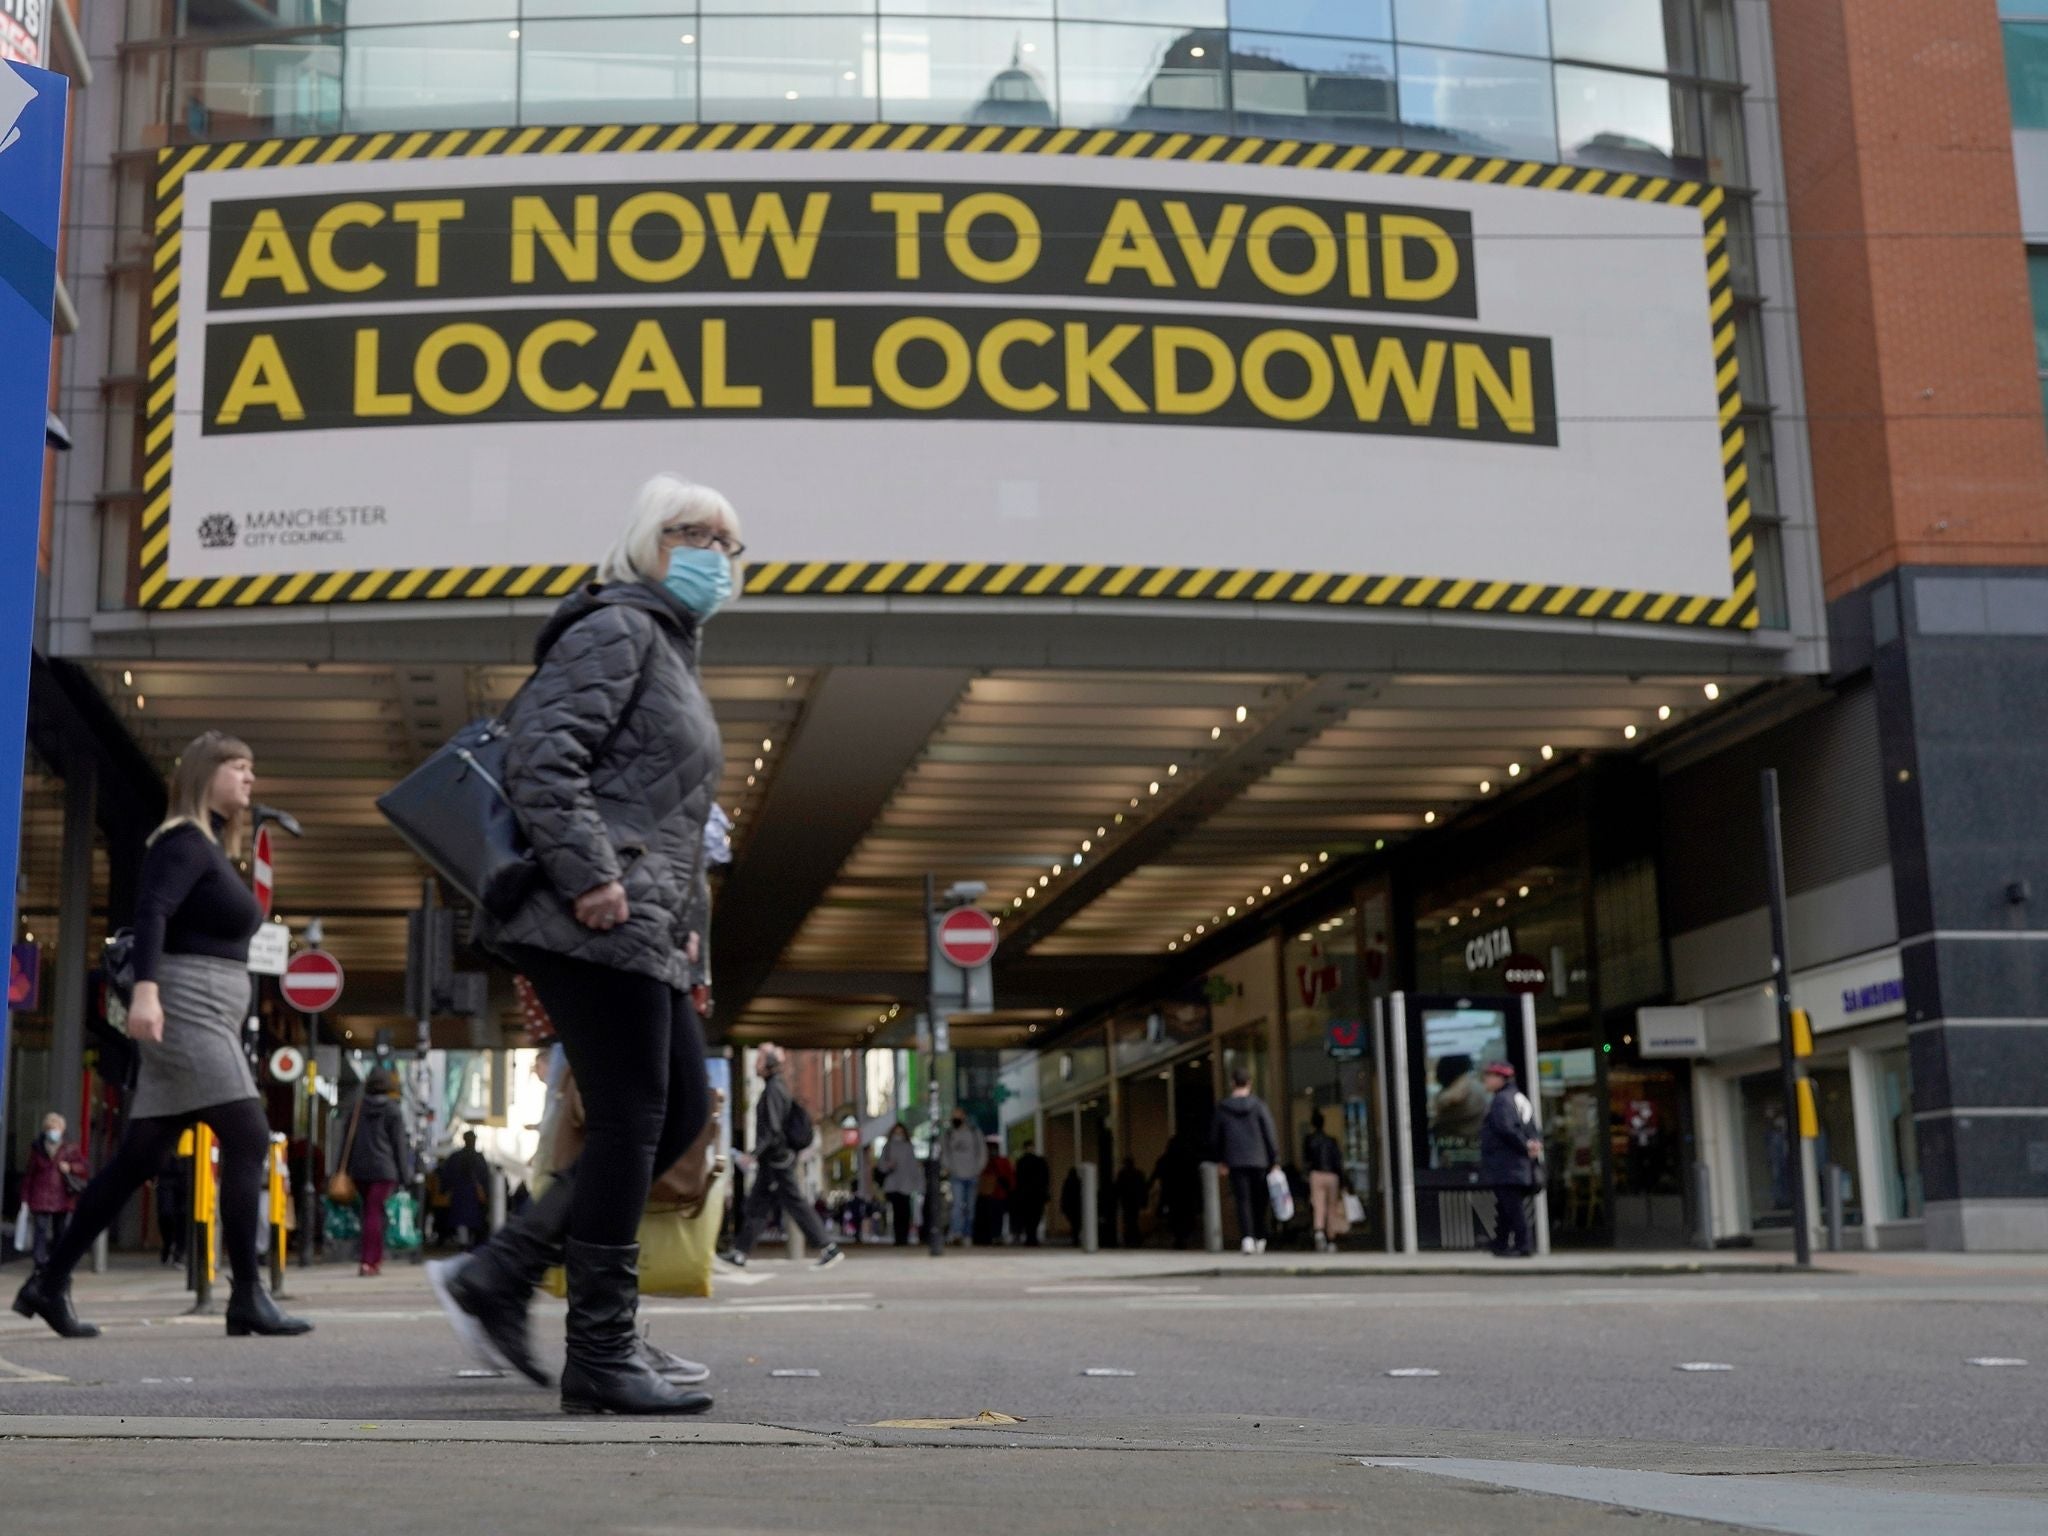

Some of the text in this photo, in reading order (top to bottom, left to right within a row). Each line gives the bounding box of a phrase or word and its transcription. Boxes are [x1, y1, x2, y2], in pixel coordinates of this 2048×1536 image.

[220, 191, 1459, 302] ACT NOW TO AVOID
[215, 316, 1536, 434] A LOCAL LOCKDOWN
[244, 529, 345, 547] CITY COUNCIL
[246, 505, 387, 529] MANCHESTER
[1465, 926, 1512, 971] COSTA
